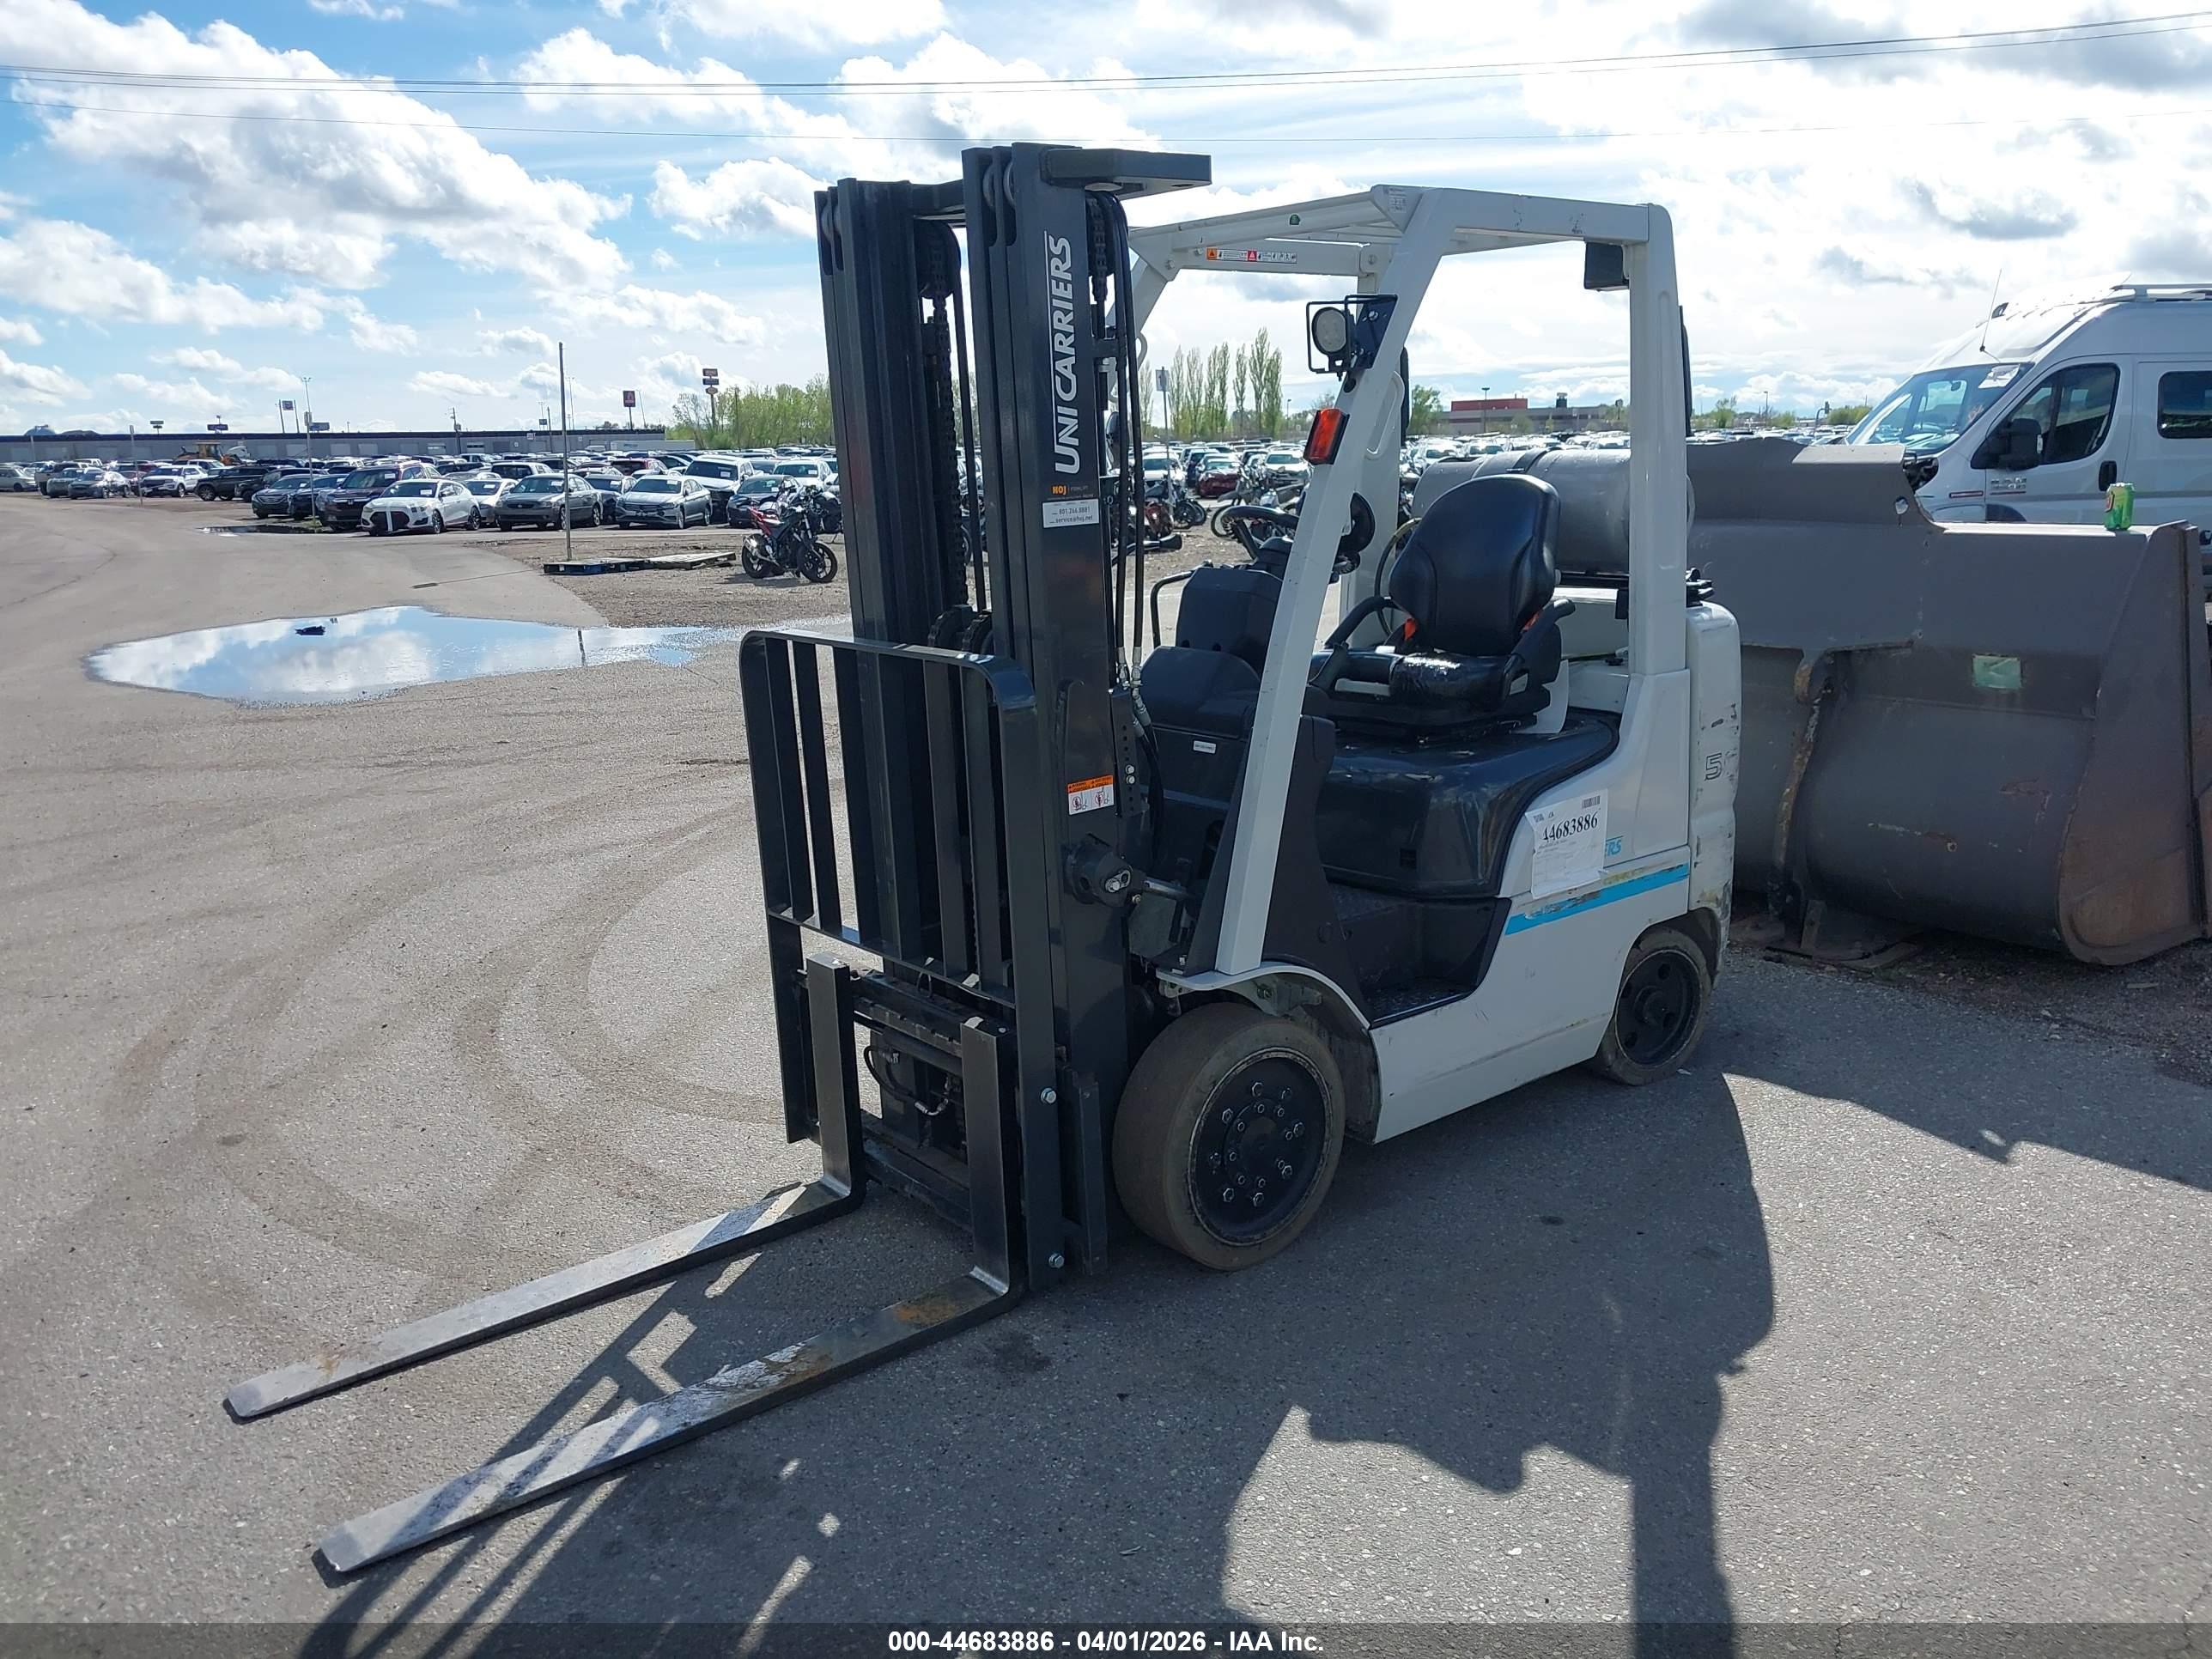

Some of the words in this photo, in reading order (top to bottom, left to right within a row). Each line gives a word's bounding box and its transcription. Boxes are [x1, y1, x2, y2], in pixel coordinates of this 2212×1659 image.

[1048, 234, 1080, 474] UNICARRIERS
[1052, 485, 1066, 495] HOJ
[1705, 752, 1723, 781] 5
[1543, 811, 1598, 841] 44683886
